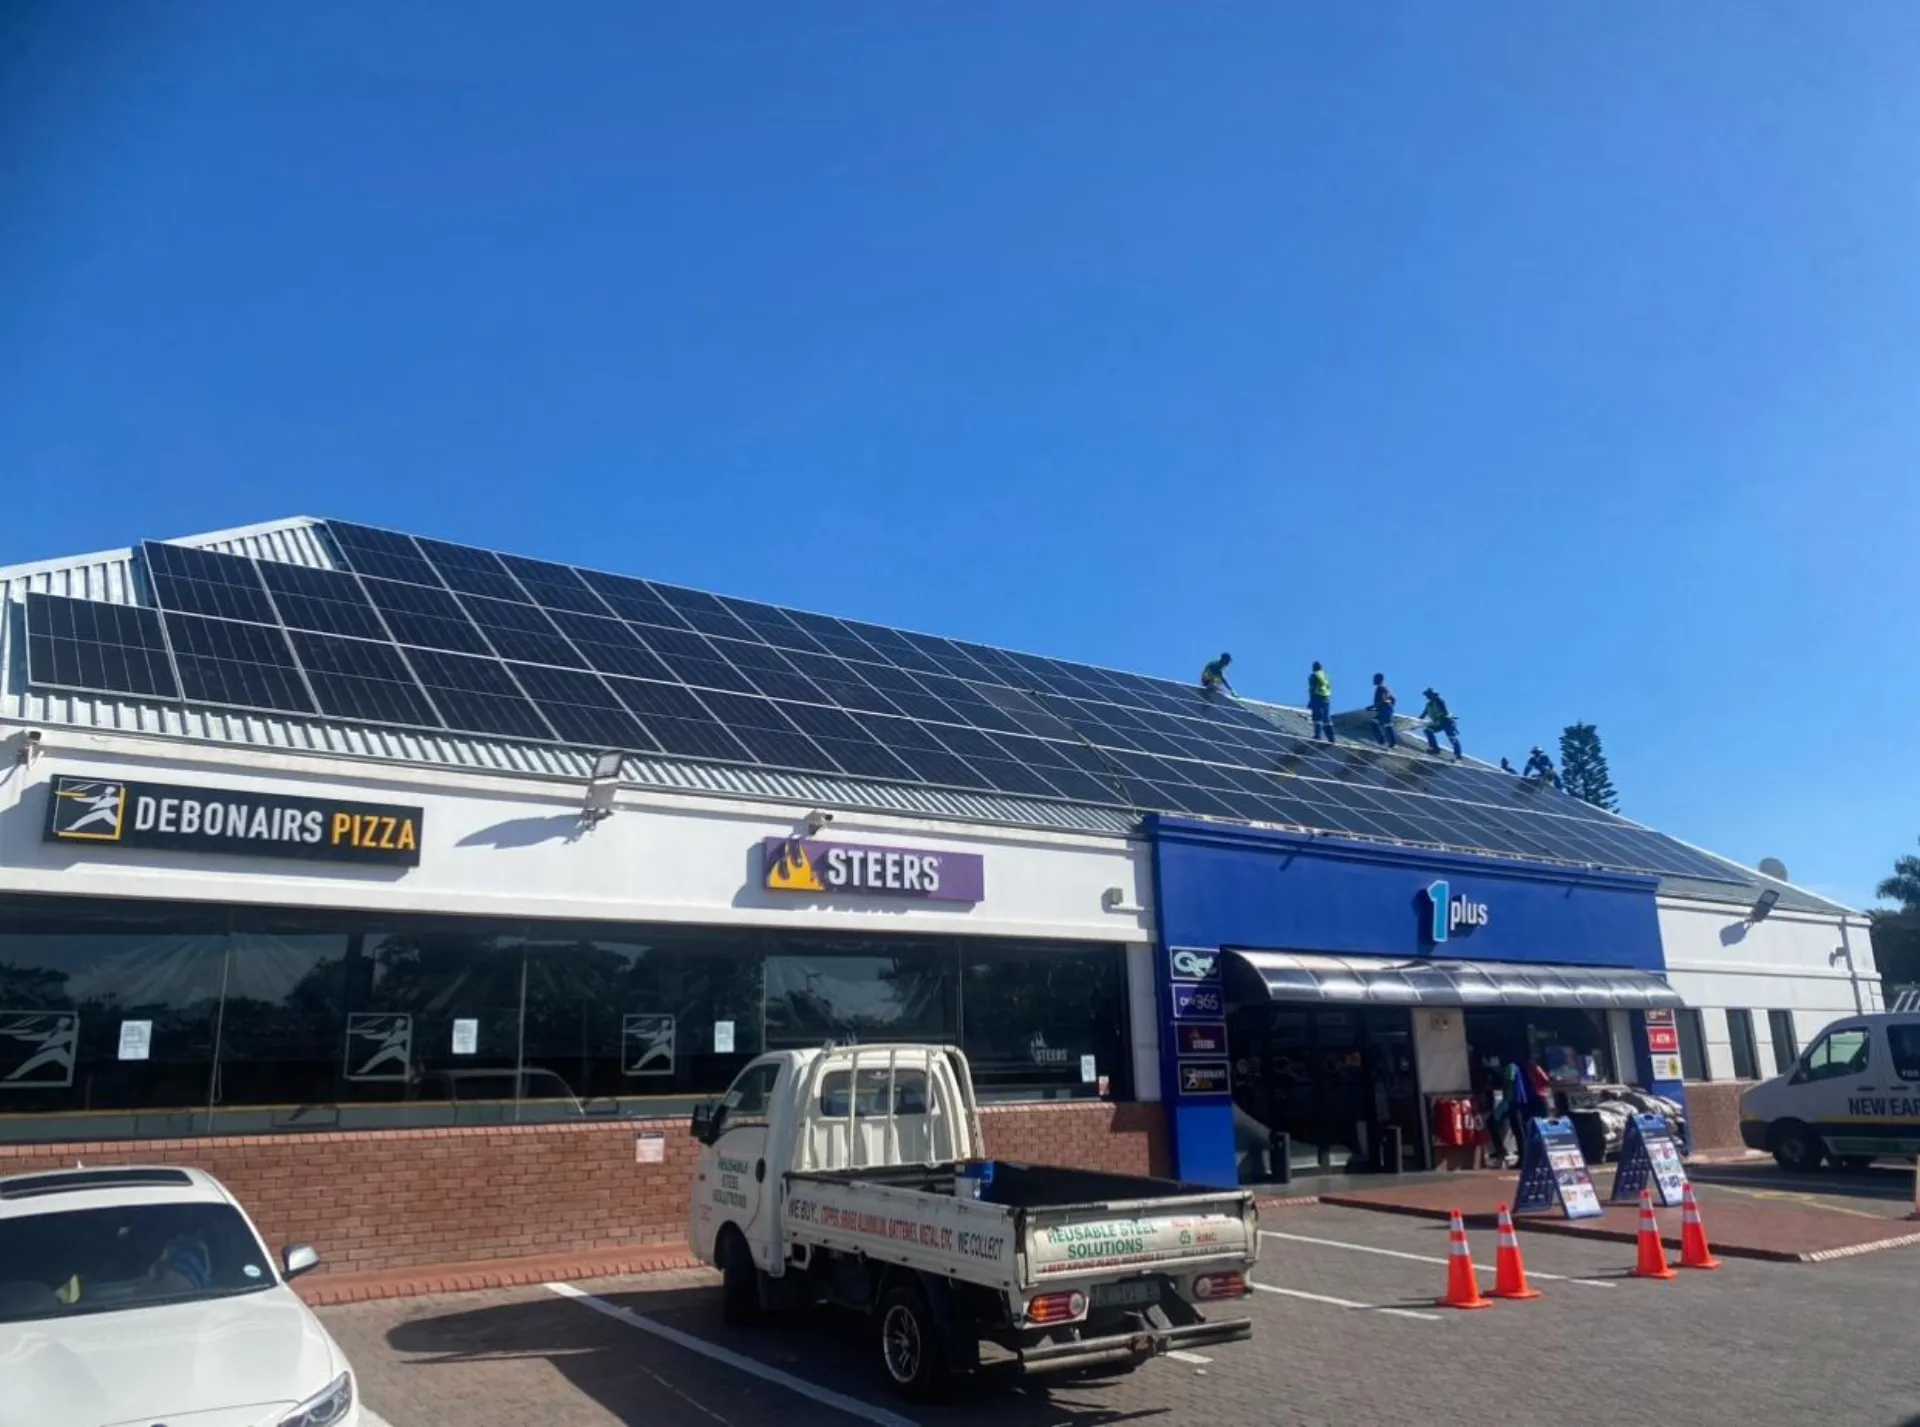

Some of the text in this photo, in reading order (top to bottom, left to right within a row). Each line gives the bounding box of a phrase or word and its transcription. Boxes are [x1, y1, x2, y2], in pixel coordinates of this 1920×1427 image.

[134, 796, 416, 850] DEBONAIRS PIZZA
[827, 848, 940, 892] STEERS
[1848, 1096, 1886, 1117] NEW
[1047, 1221, 1117, 1244] REUSABLE
[1119, 1217, 1158, 1238] STEEL
[1067, 1238, 1144, 1259] SOLUTIONS
